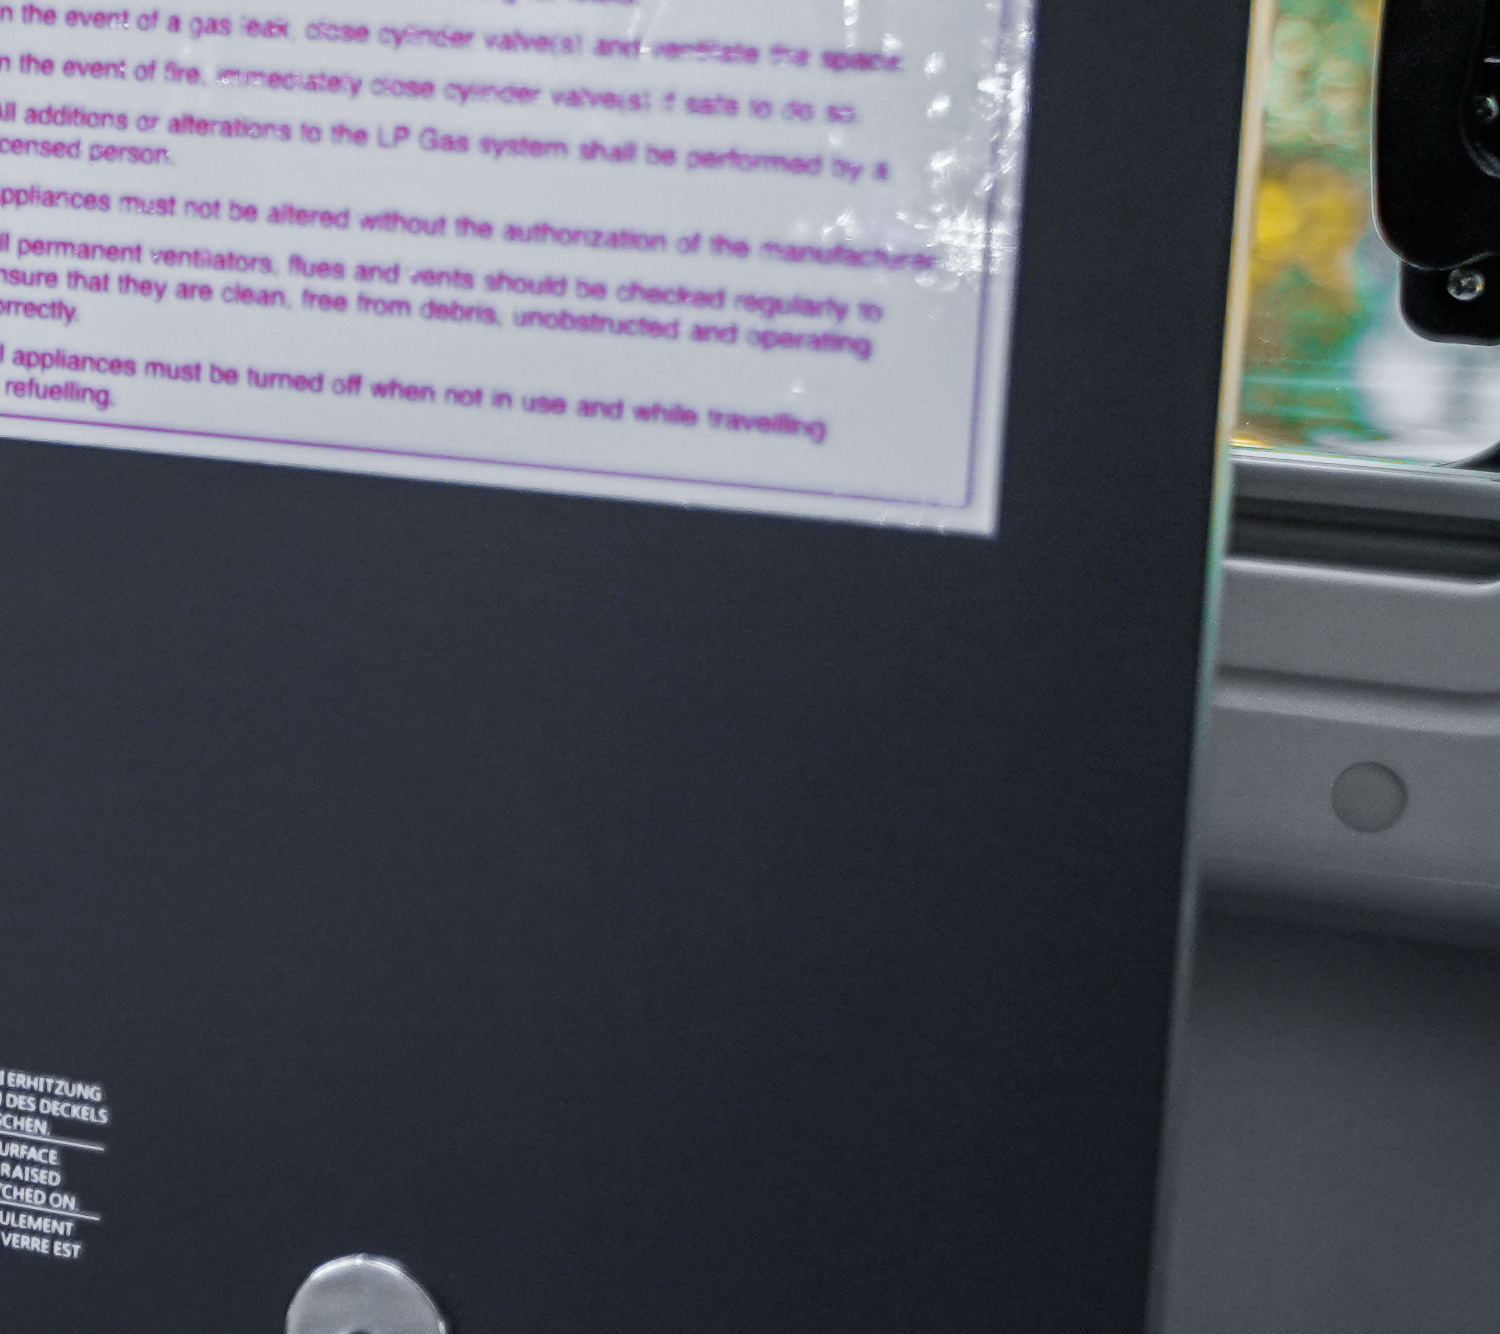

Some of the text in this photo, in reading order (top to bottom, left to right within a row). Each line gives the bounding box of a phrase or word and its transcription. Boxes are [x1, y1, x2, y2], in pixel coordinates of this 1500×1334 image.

[13, 347, 138, 379] appliances
[7, 1071, 102, 1102] ERHITZUNG
[5, 1092, 37, 1112] DES
[39, 1098, 109, 1124] DECKELS
[0, 1162, 61, 1187] RAISED
[1, 1231, 50, 1254] VERRE
[53, 1240, 82, 1258] EST
